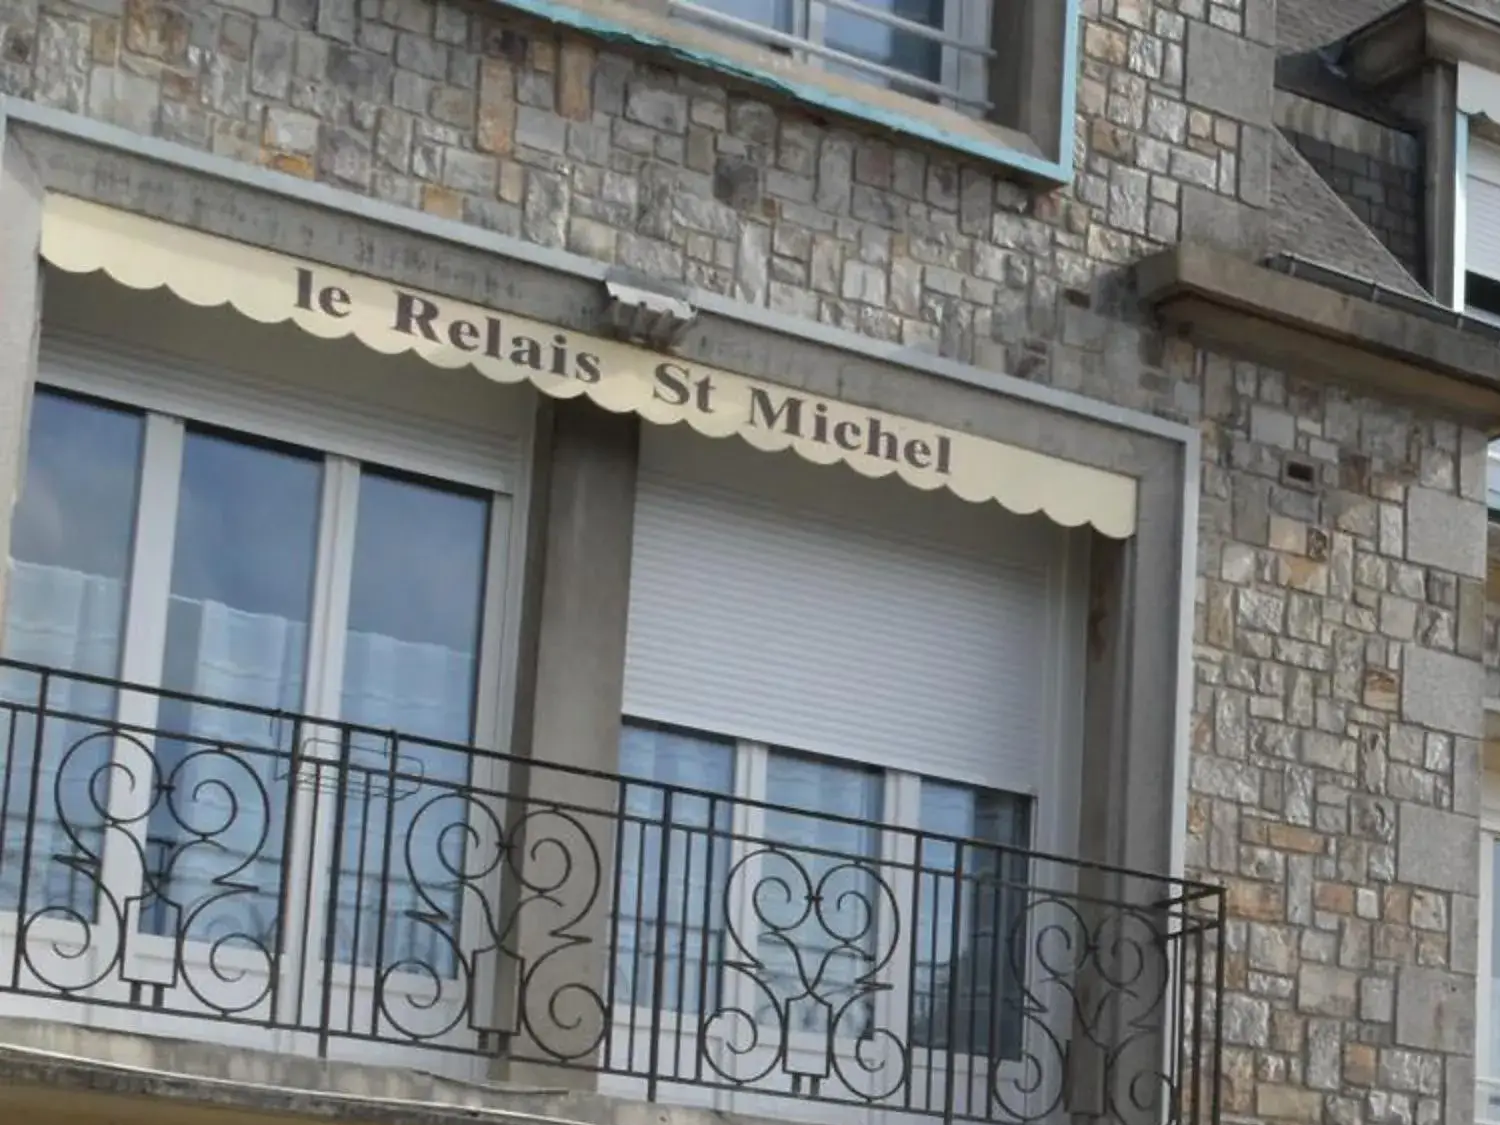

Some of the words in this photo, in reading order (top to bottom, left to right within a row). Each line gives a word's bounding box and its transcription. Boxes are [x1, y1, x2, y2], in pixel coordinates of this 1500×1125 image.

[294, 267, 352, 318] le
[390, 289, 602, 384] Relais
[653, 362, 715, 414] St
[746, 386, 952, 475] Michel
